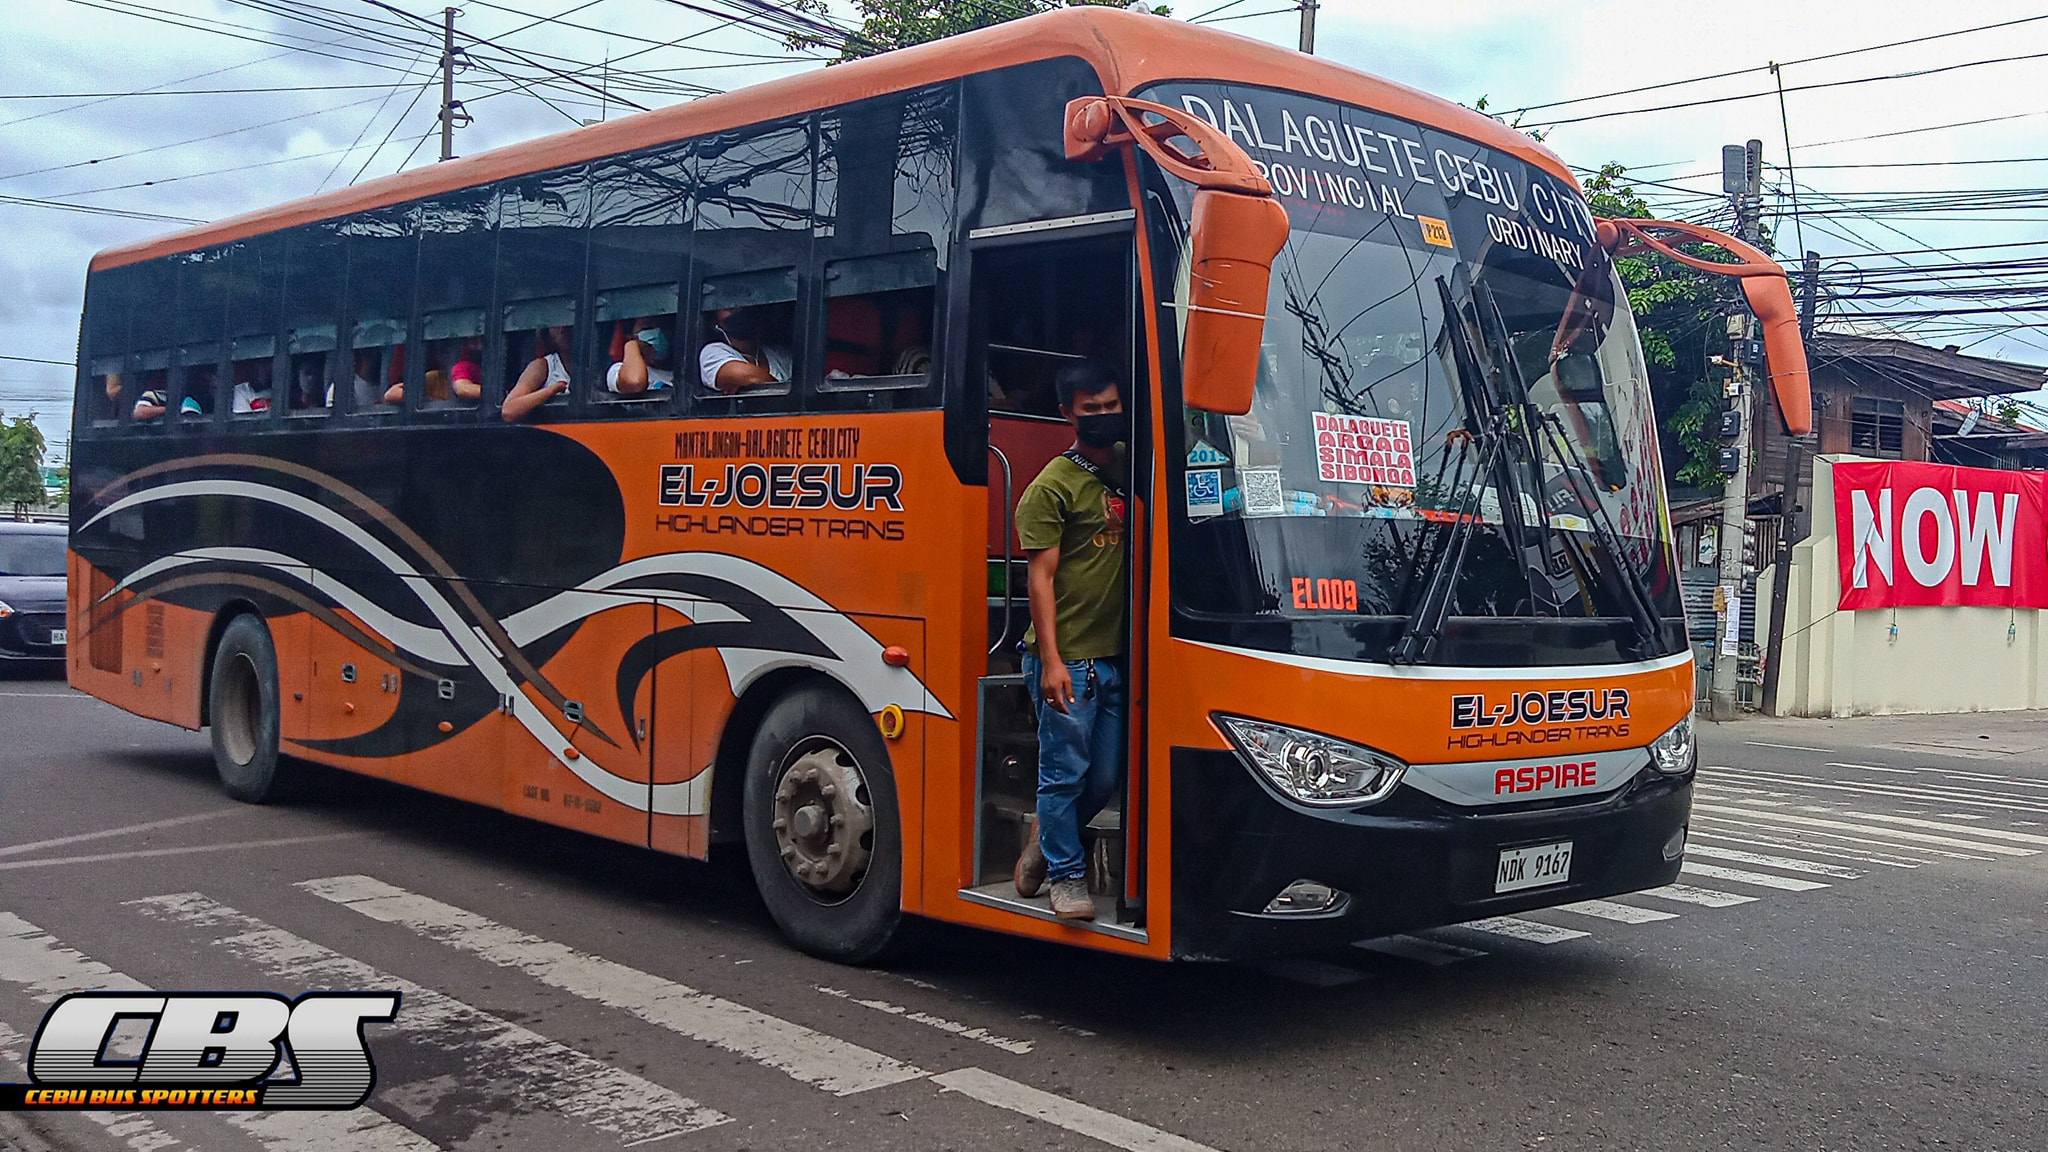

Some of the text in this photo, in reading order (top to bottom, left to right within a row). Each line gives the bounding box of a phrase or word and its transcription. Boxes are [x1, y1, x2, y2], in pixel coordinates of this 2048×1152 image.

[1181, 94, 1599, 244] DALAGUETE CEBU CITY
[1252, 159, 1415, 220] OVINCIAL
[1486, 212, 1585, 270] ORDINARY
[1318, 431, 1410, 453] ARGAO
[1319, 447, 1412, 469] SIMALA
[1070, 453, 1100, 474] NIKE
[1321, 463, 1415, 484] SIBONGA
[658, 463, 905, 512] EL-JOESUR
[655, 513, 905, 541] HIGHLANDER TRANS
[1850, 486, 2020, 589] NOW
[1291, 577, 1358, 611] EL009
[1450, 687, 1631, 730] EL-JOESUR
[1447, 723, 1630, 750] HIGHLANDER TRANS
[1494, 761, 1597, 795] ASPIRE
[1499, 850, 1570, 884] NDK 9167
